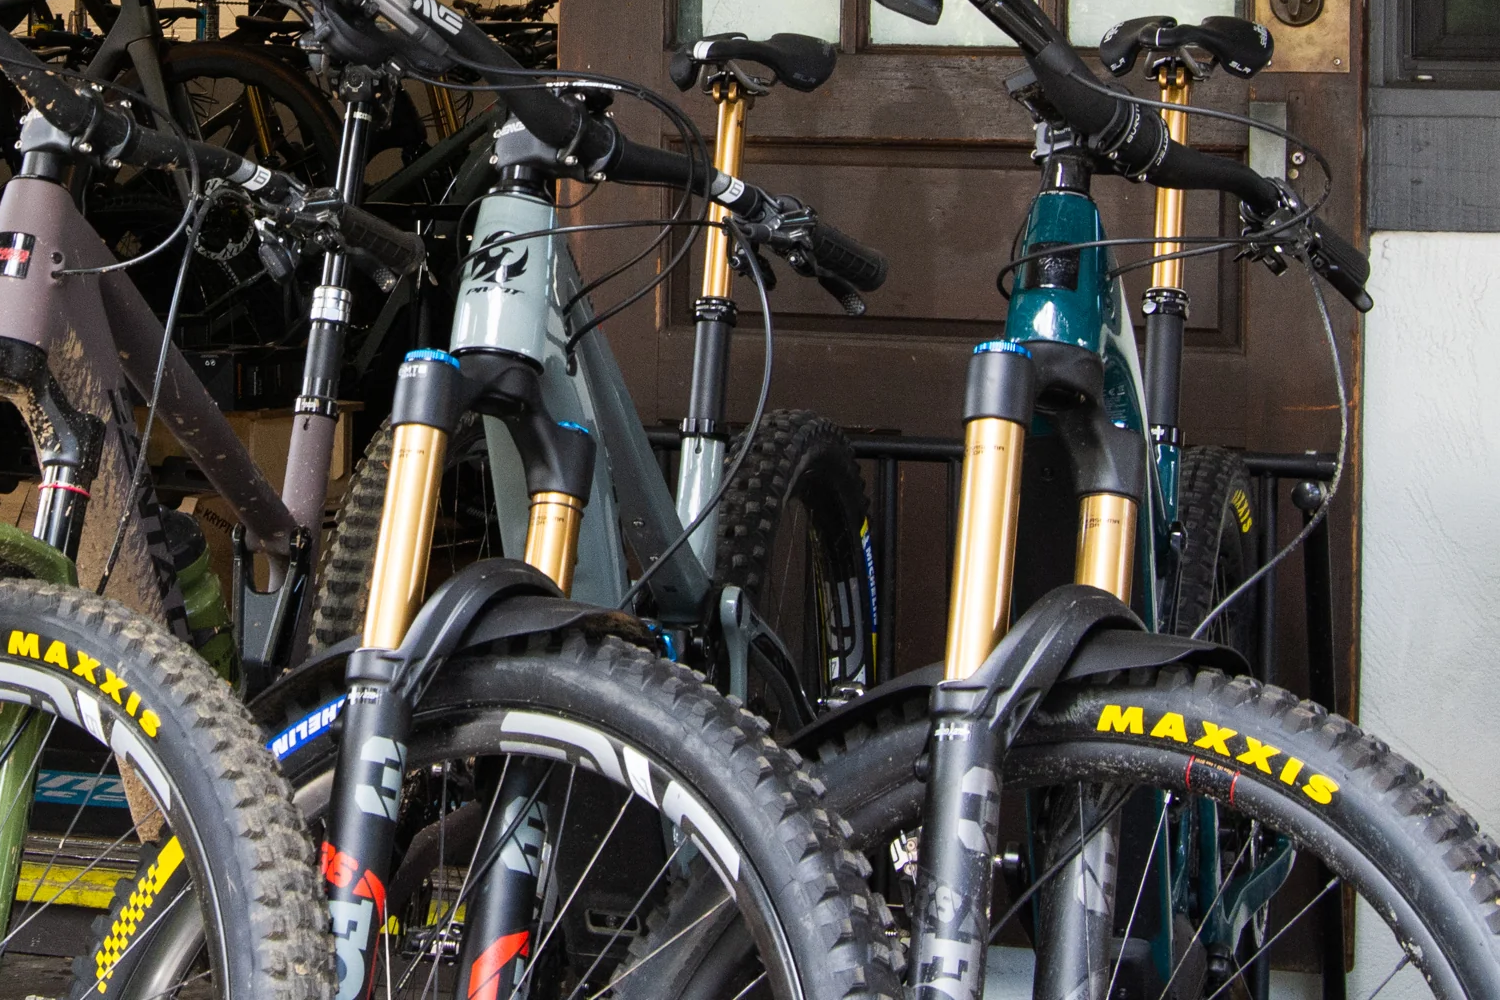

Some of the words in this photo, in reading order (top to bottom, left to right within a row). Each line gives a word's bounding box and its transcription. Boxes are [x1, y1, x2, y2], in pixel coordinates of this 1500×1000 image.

[1228, 60, 1252, 75] SLR
[203, 506, 235, 536] KRYPT
[8, 629, 163, 738] MAXXIS
[271, 703, 341, 758] HELIN
[1096, 704, 1340, 805] MAXXIS
